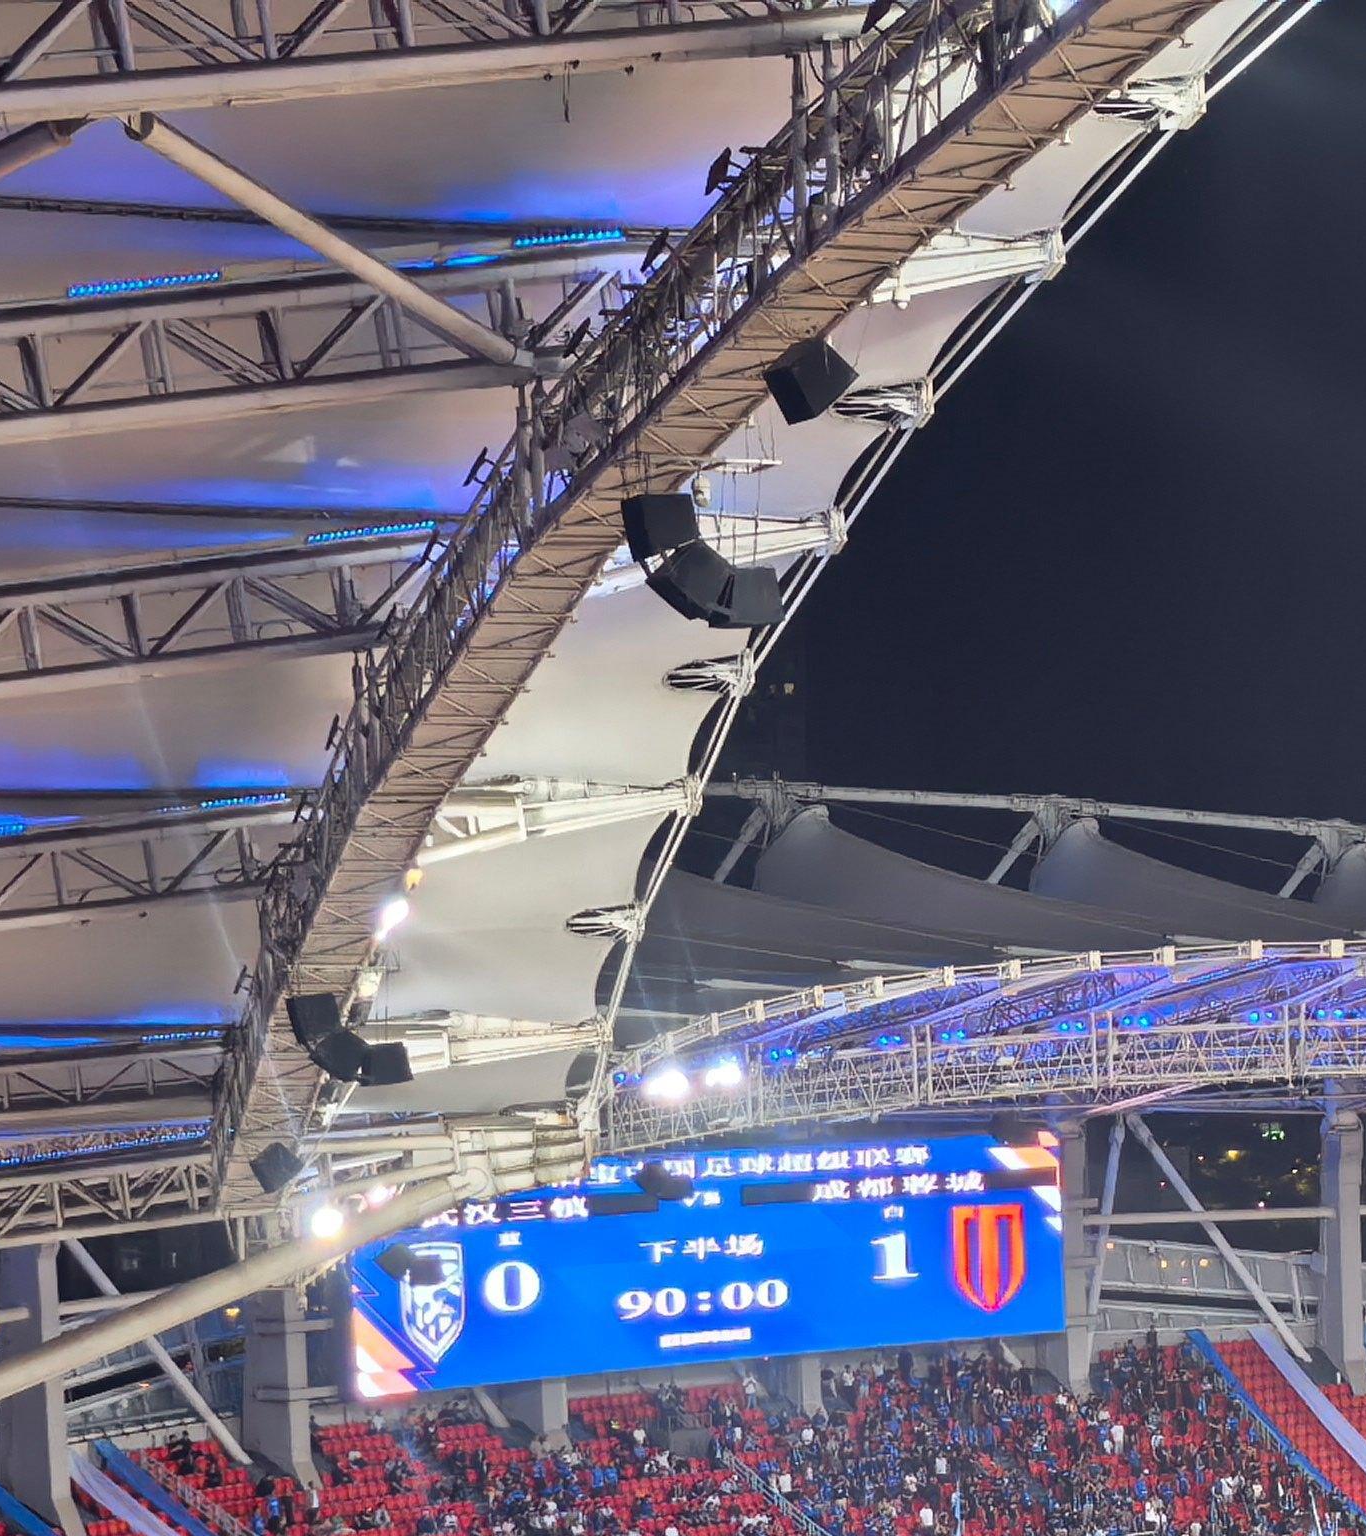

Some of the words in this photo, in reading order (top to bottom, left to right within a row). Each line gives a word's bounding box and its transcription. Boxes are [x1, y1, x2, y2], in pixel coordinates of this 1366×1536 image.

[639, 1233, 765, 1265] 下半场
[869, 1231, 920, 1281] 1
[484, 1261, 541, 1313] 0
[616, 1278, 789, 1322] 90:00
